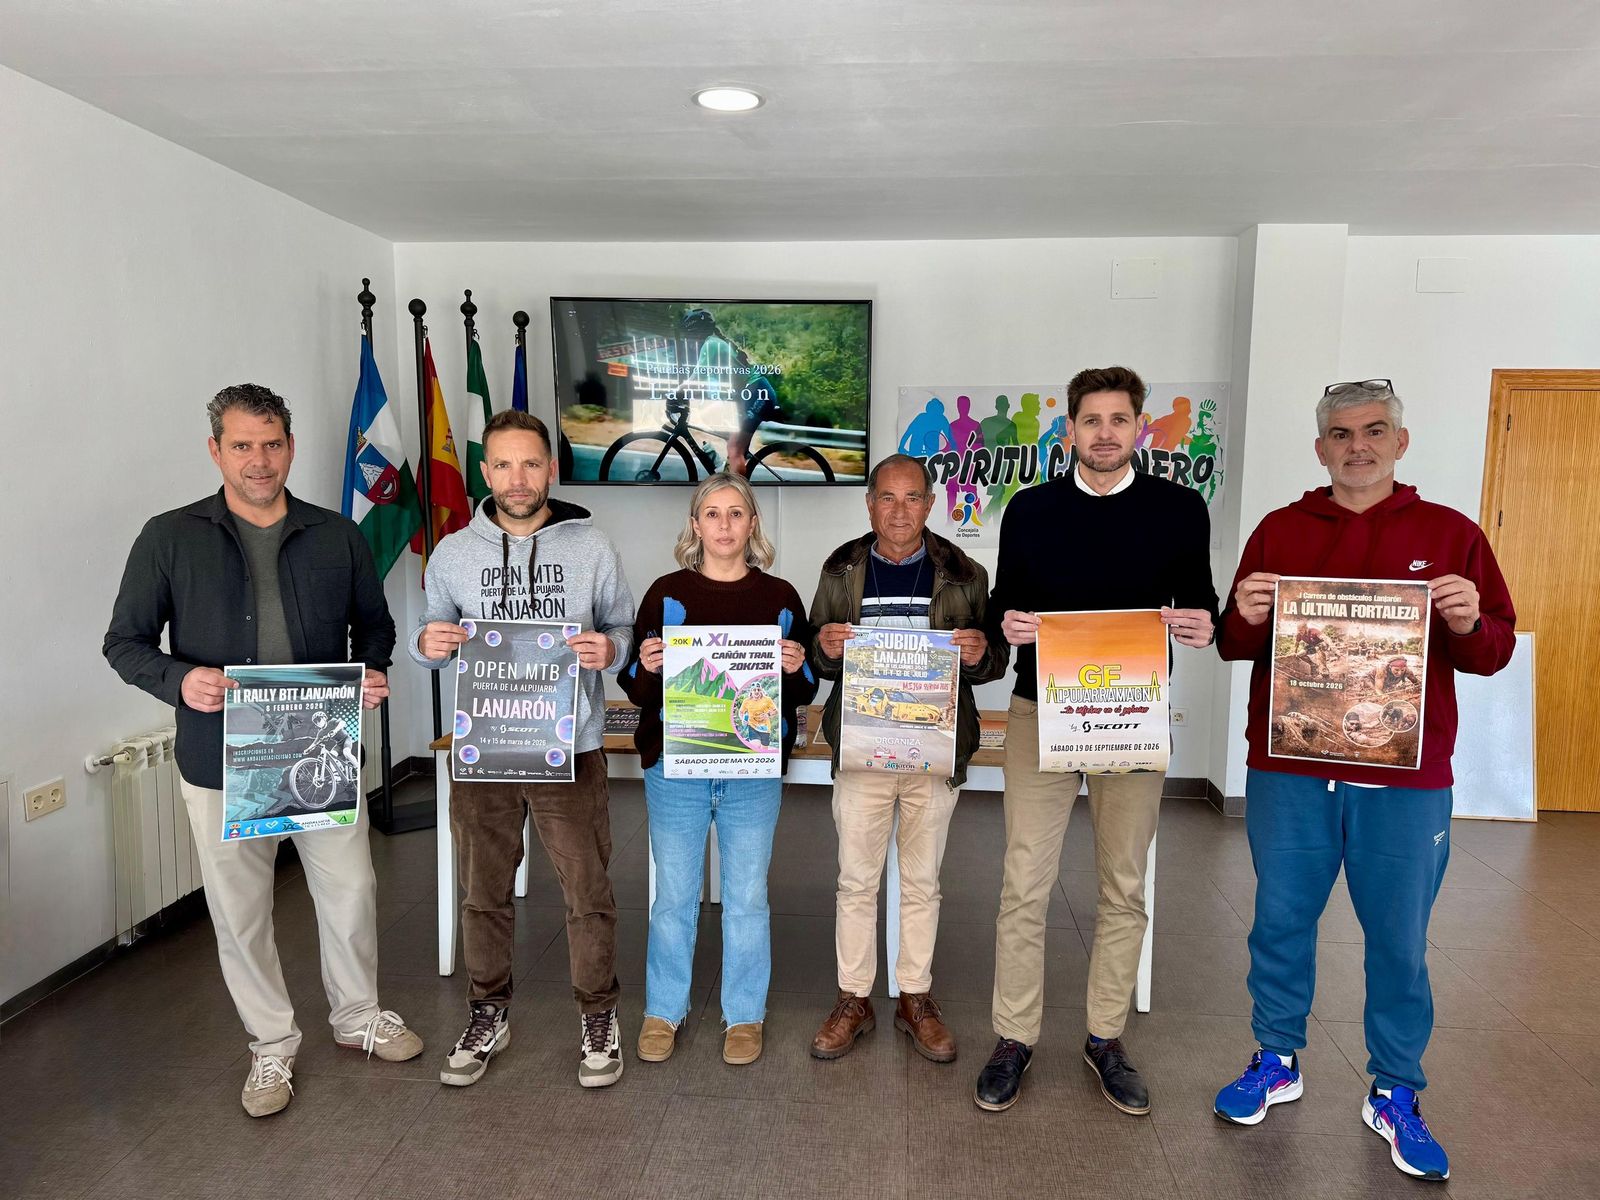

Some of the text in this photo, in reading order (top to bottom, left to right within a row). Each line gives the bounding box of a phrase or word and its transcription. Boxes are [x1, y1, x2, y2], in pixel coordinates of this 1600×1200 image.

[647, 363, 781, 376] Pruebas deportivas 2026
[649, 383, 770, 404] Lanjarón
[1412, 559, 1427, 567] NIKE
[481, 564, 564, 587] OPEN MTB
[507, 587, 516, 596] DE
[518, 586, 527, 595] LA
[1303, 592, 1327, 600] Carrera
[1336, 593, 1373, 602] obstáculos
[1374, 594, 1402, 603] Lanjarón
[481, 593, 566, 620] LANJARÓN
[1283, 599, 1420, 620] LA ÚLTIMA FORTALEZA
[706, 633, 775, 647] XI LANJARÓN
[874, 632, 928, 652] SUBIDA
[711, 650, 747, 660] CAÑÓN
[873, 650, 928, 666] LANJARÓN
[474, 660, 560, 681] OPEN MTB
[729, 662, 774, 671] 20K/13K
[1078, 664, 1122, 689] GF
[472, 682, 557, 693] PUERTA DE LA ALPUJARRA
[1325, 682, 1343, 690] 2026
[233, 685, 356, 703] II RALLY BTT LANJARÓN
[472, 695, 557, 720] LANJARÓN
[875, 736, 924, 746] ORGANIZA:
[1050, 744, 1074, 752] SÁBADO
[1075, 744, 1083, 752] 19
[1094, 743, 1132, 752] SEPTIEMBRE
[1133, 743, 1142, 751] DE
[1143, 742, 1160, 751] 2026
[674, 757, 707, 765] SÁBADO
